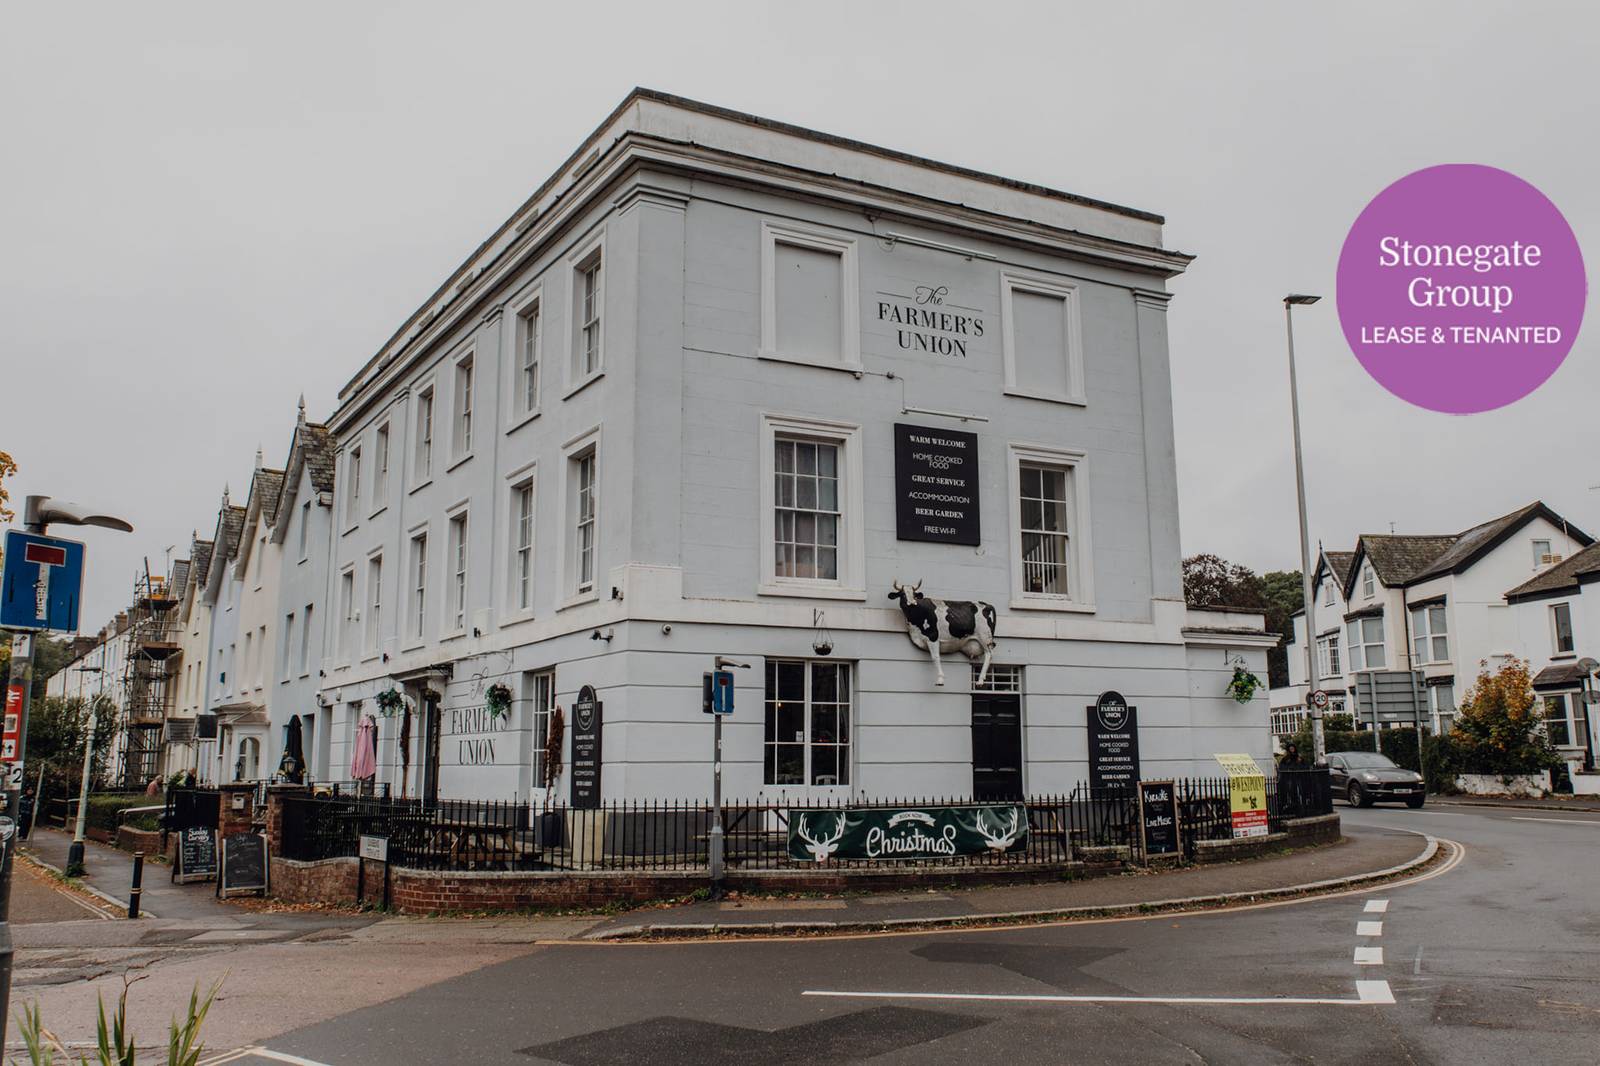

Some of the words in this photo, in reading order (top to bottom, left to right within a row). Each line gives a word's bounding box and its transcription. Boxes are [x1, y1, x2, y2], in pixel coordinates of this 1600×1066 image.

[915, 286, 949, 306] The
[877, 302, 984, 337] FARMER'S
[897, 329, 968, 358] UNION
[909, 435, 931, 445] WARM
[931, 438, 966, 449] WELCOME
[912, 453, 933, 461] HOME
[934, 455, 963, 465] COOKED
[929, 461, 949, 470] FOOD
[911, 475, 935, 484] GREAT
[936, 478, 966, 487] SERVICE
[908, 492, 970, 504] ACCOMMODATION
[915, 508, 934, 516] BEER
[935, 510, 964, 519] GARDEN
[924, 525, 939, 534] FREE
[939, 527, 956, 535] WI-FI
[1315, 694, 1326, 702] 20
[459, 739, 495, 766] UNION
[12, 768, 22, 784] 2
